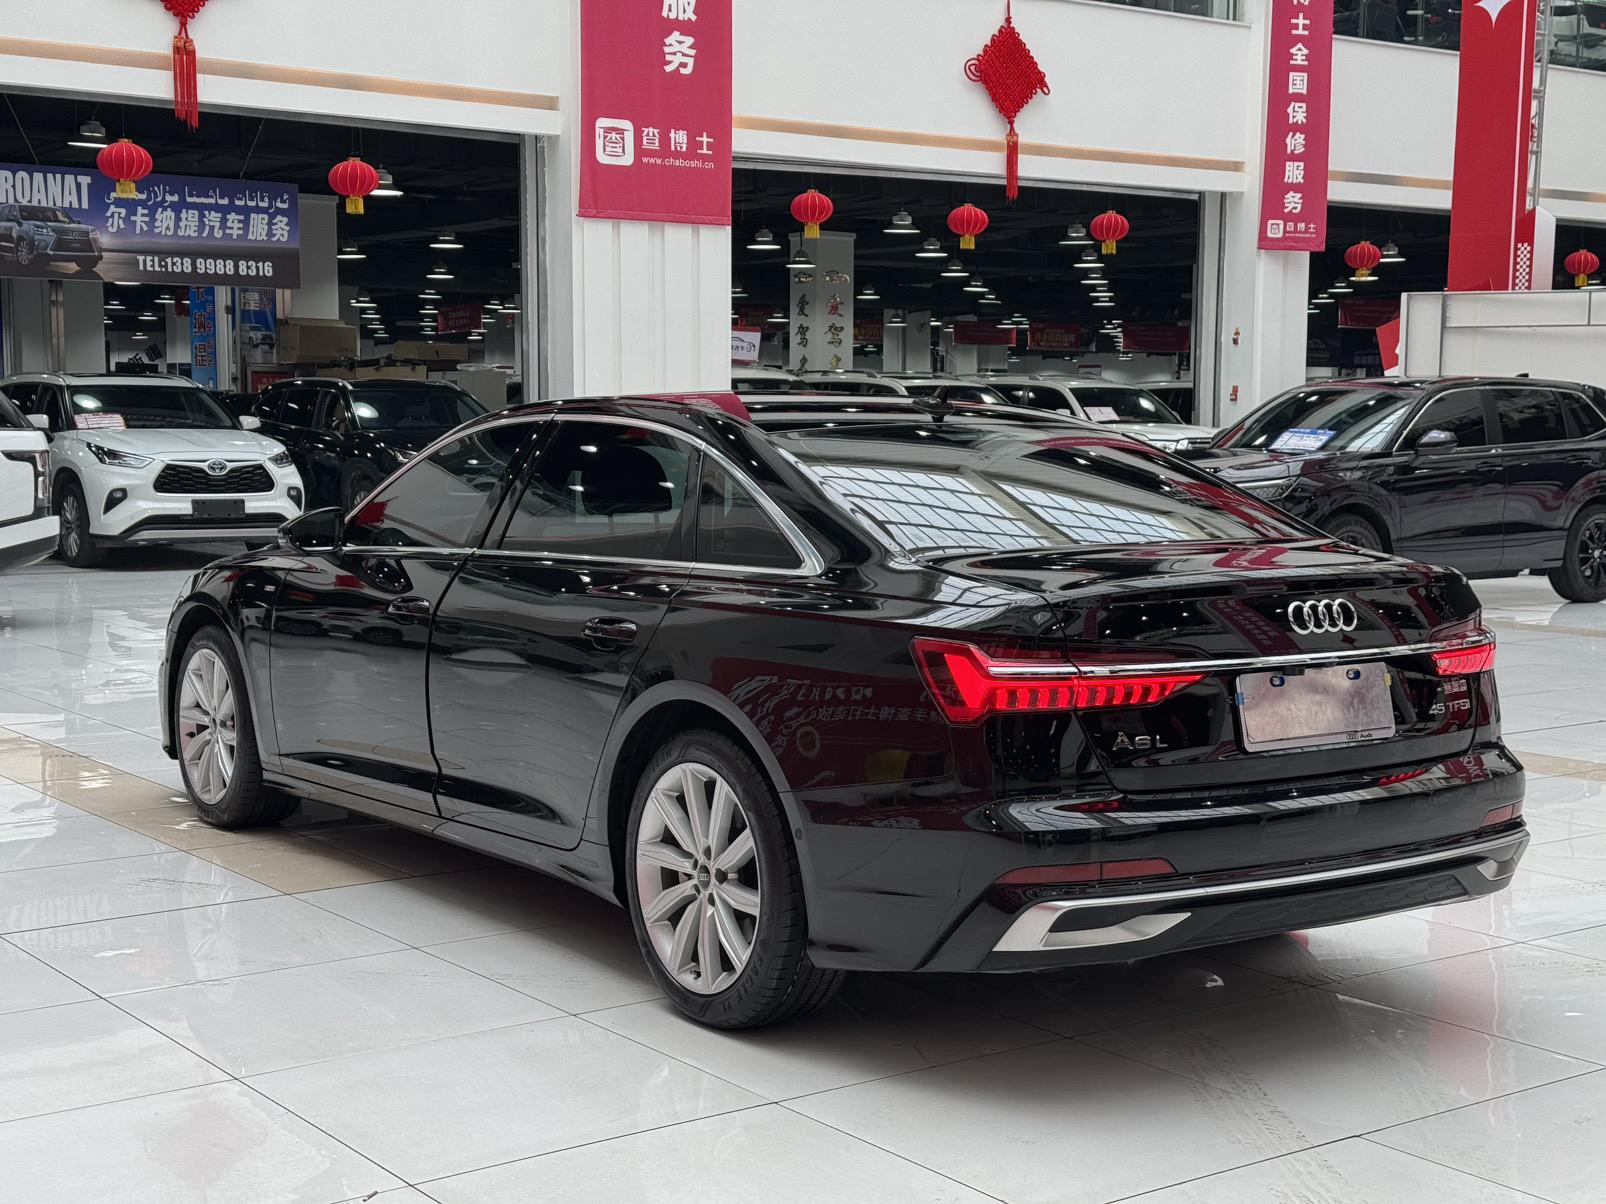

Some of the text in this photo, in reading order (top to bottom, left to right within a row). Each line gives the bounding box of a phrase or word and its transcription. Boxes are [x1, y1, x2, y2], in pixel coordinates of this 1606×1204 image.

[1283, 0, 1311, 214] 士全国保修服务
[641, 127, 714, 155] 查博士
[641, 156, 714, 169] www.chaboshi.cn
[104, 204, 291, 242] 尔卡纳提汽车服务
[137, 255, 273, 277] TEL:138 9988 8316
[1429, 698, 1471, 714] 45 TFSI
[1360, 731, 1374, 739] Audi
